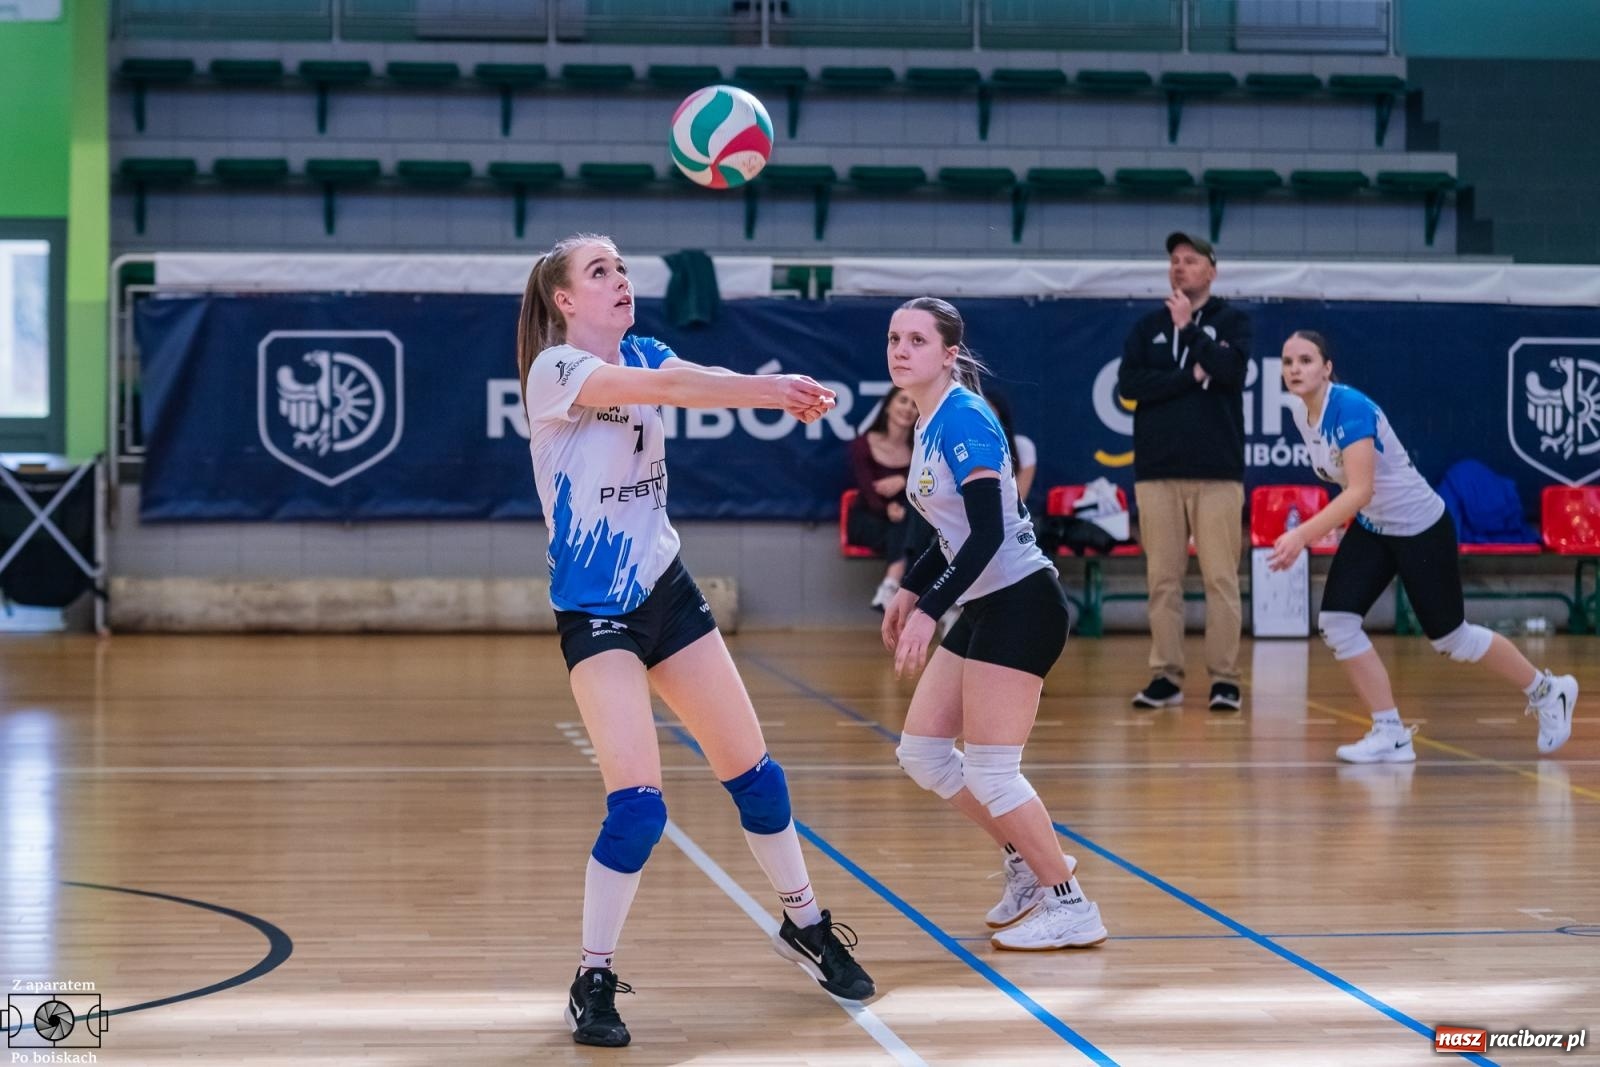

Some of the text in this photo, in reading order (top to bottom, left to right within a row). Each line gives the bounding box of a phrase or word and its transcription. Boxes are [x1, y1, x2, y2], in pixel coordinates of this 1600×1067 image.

[596, 412, 630, 424] VOLLEY
[633, 422, 643, 454] 7
[932, 564, 957, 591] KIPSTA
